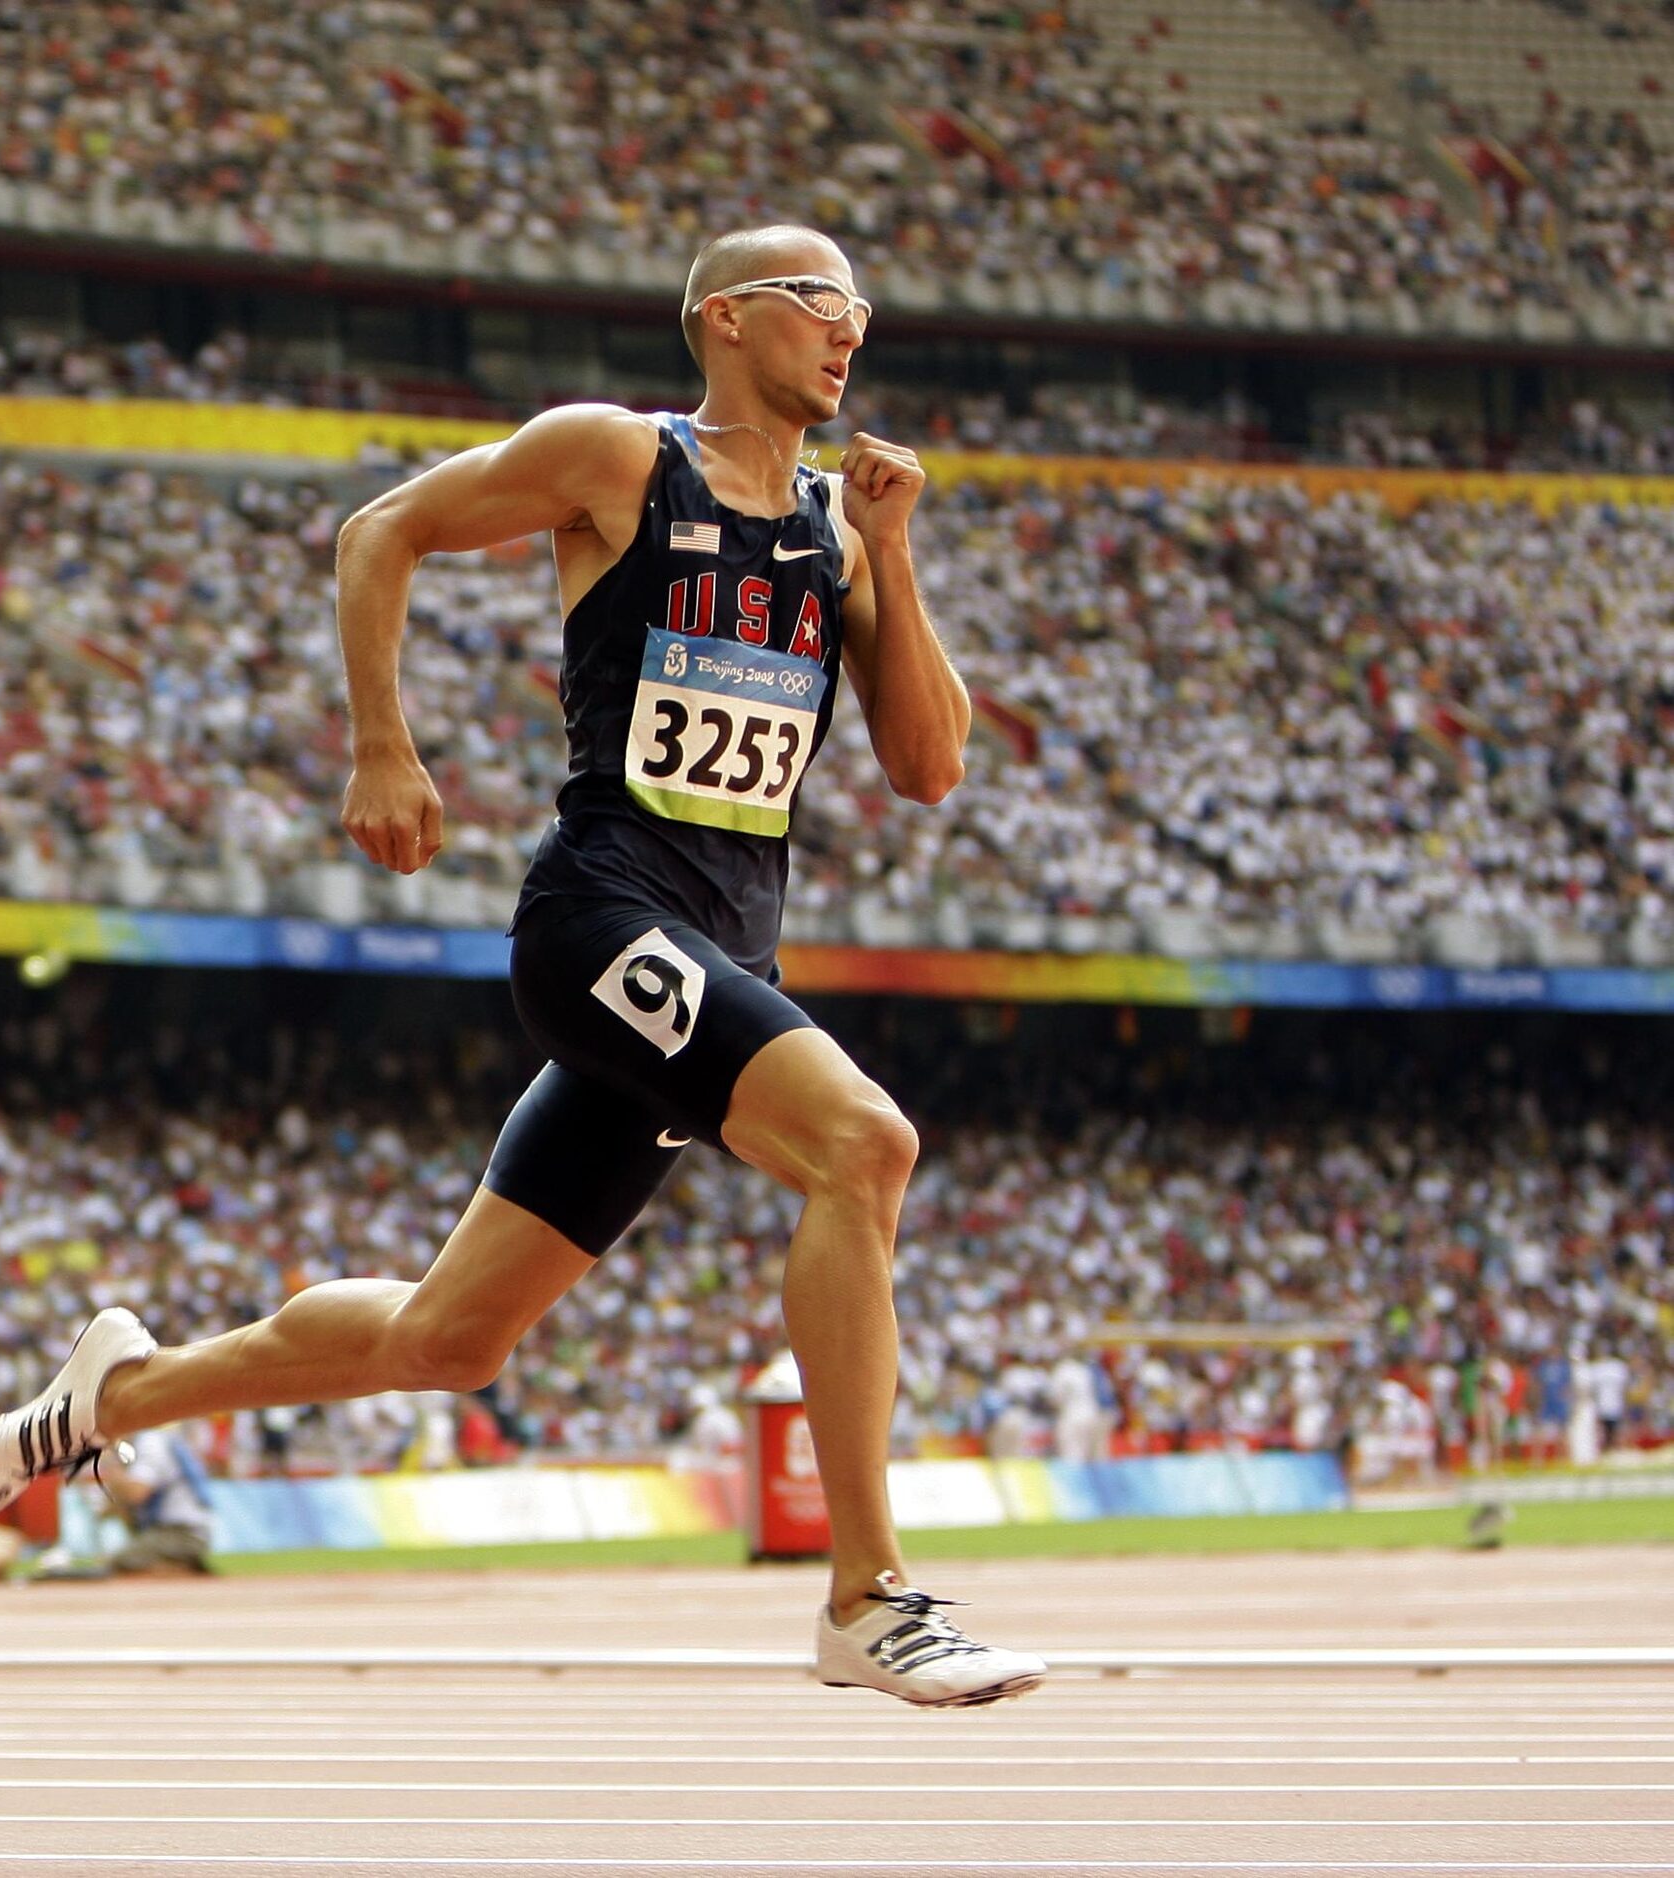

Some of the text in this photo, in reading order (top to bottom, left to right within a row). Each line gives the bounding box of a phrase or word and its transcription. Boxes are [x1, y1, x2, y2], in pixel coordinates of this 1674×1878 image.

[665, 571, 821, 662] USA
[694, 655, 775, 686] Beijing 2008
[641, 698, 800, 799] 3253
[622, 954, 692, 1038] 9
